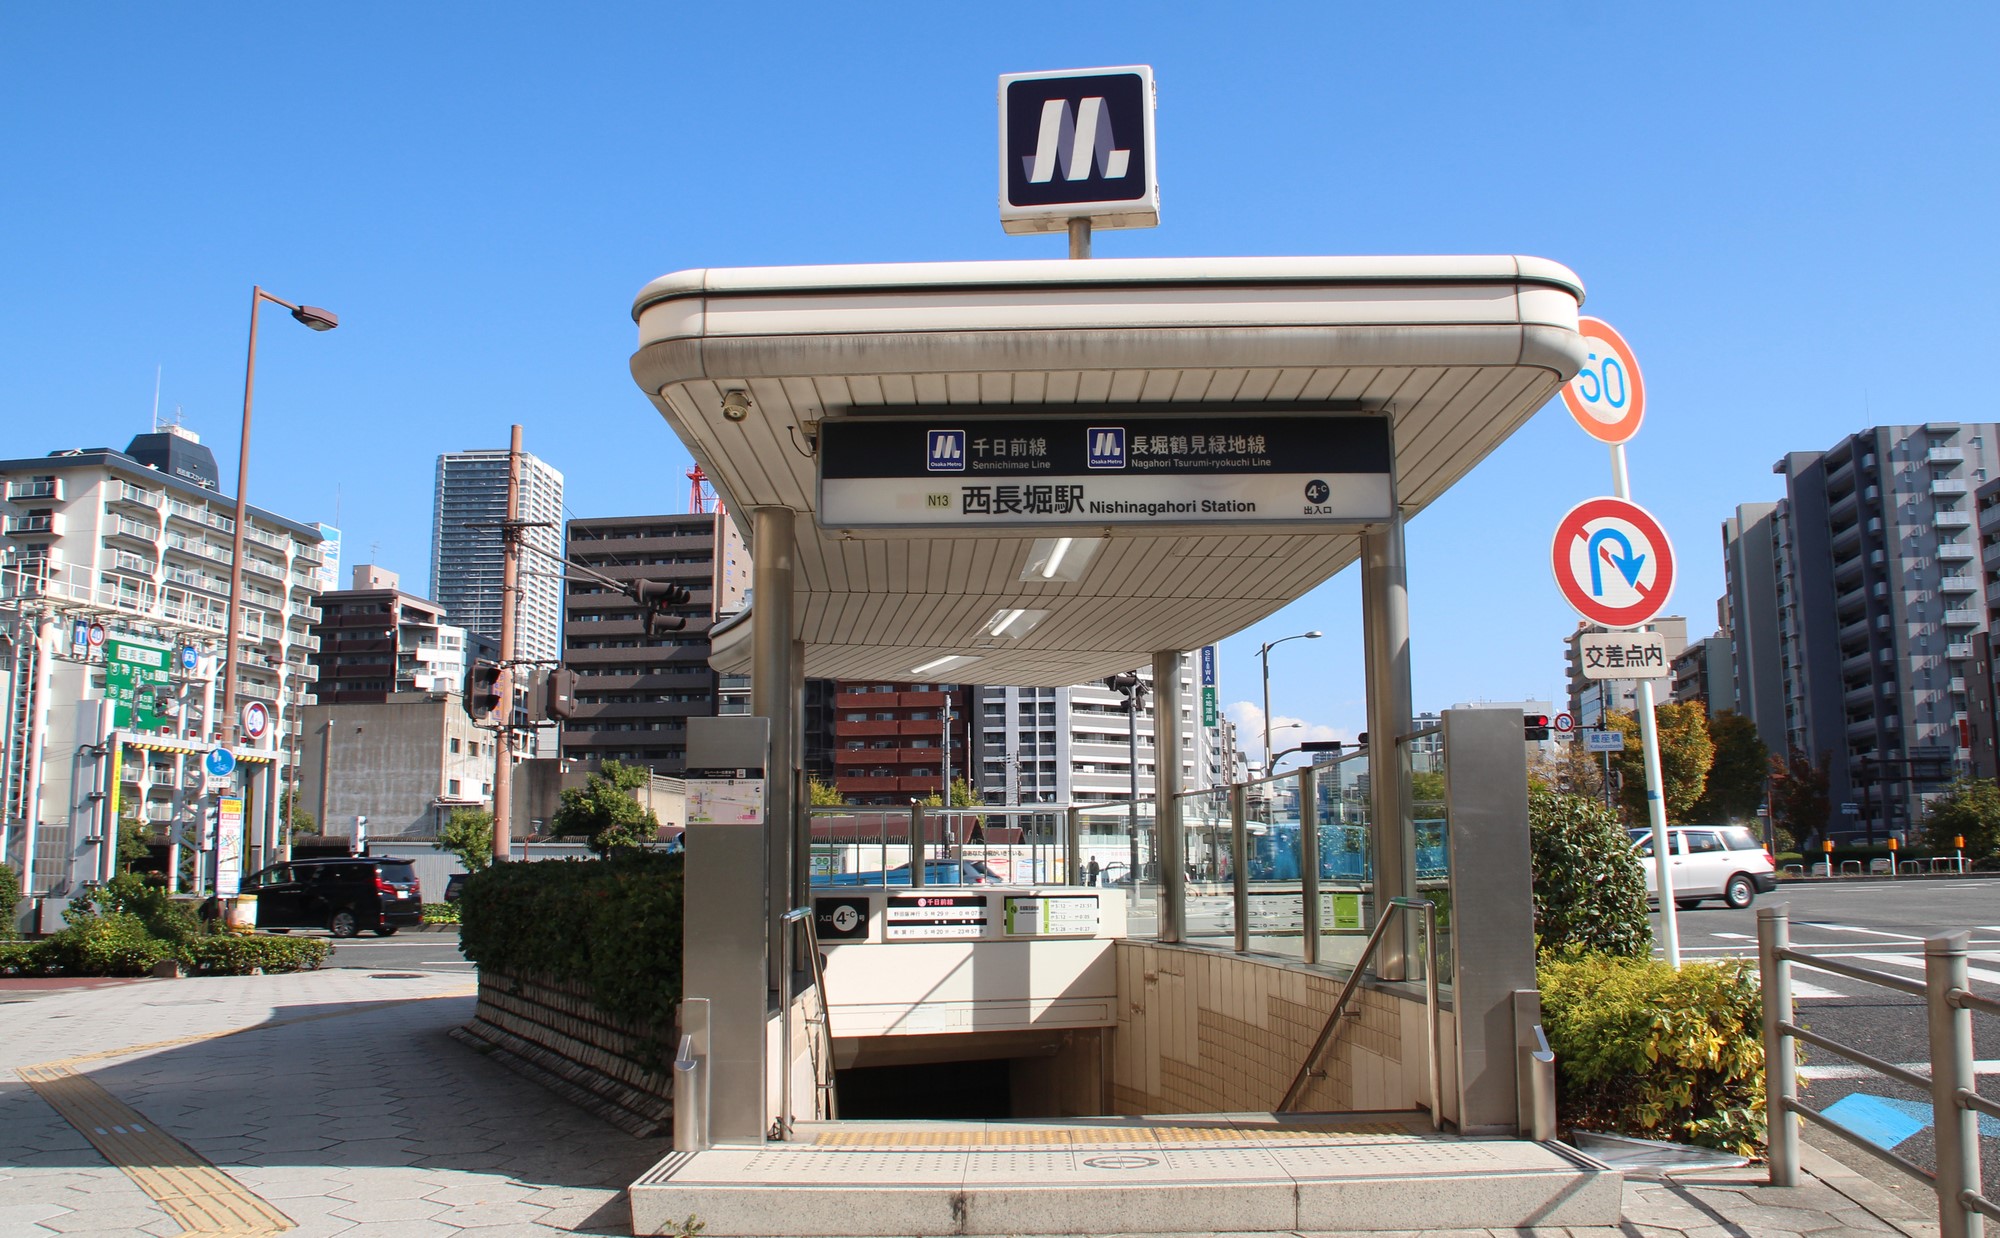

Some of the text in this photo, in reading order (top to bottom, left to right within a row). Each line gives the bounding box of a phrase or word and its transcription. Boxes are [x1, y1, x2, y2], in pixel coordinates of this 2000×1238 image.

[1579, 352, 1626, 409] 50
[972, 437, 1047, 457] 千日前線
[1131, 434, 1266, 455] 長堀鶴見緑地線
[972, 460, 1051, 470] Sennichimae Line
[1131, 457, 1271, 469] Nagahori Tsurumi-ryokuchi Line
[928, 495, 949, 507] N13
[961, 484, 1085, 515] 西長堀駅
[1090, 499, 1256, 517] Nishinagahori Station
[1304, 505, 1332, 515] 出入口
[1585, 643, 1663, 668] 交差点内
[927, 898, 954, 906] 千日前線
[819, 914, 832, 922] 入口
[835, 911, 855, 925] 4-C
